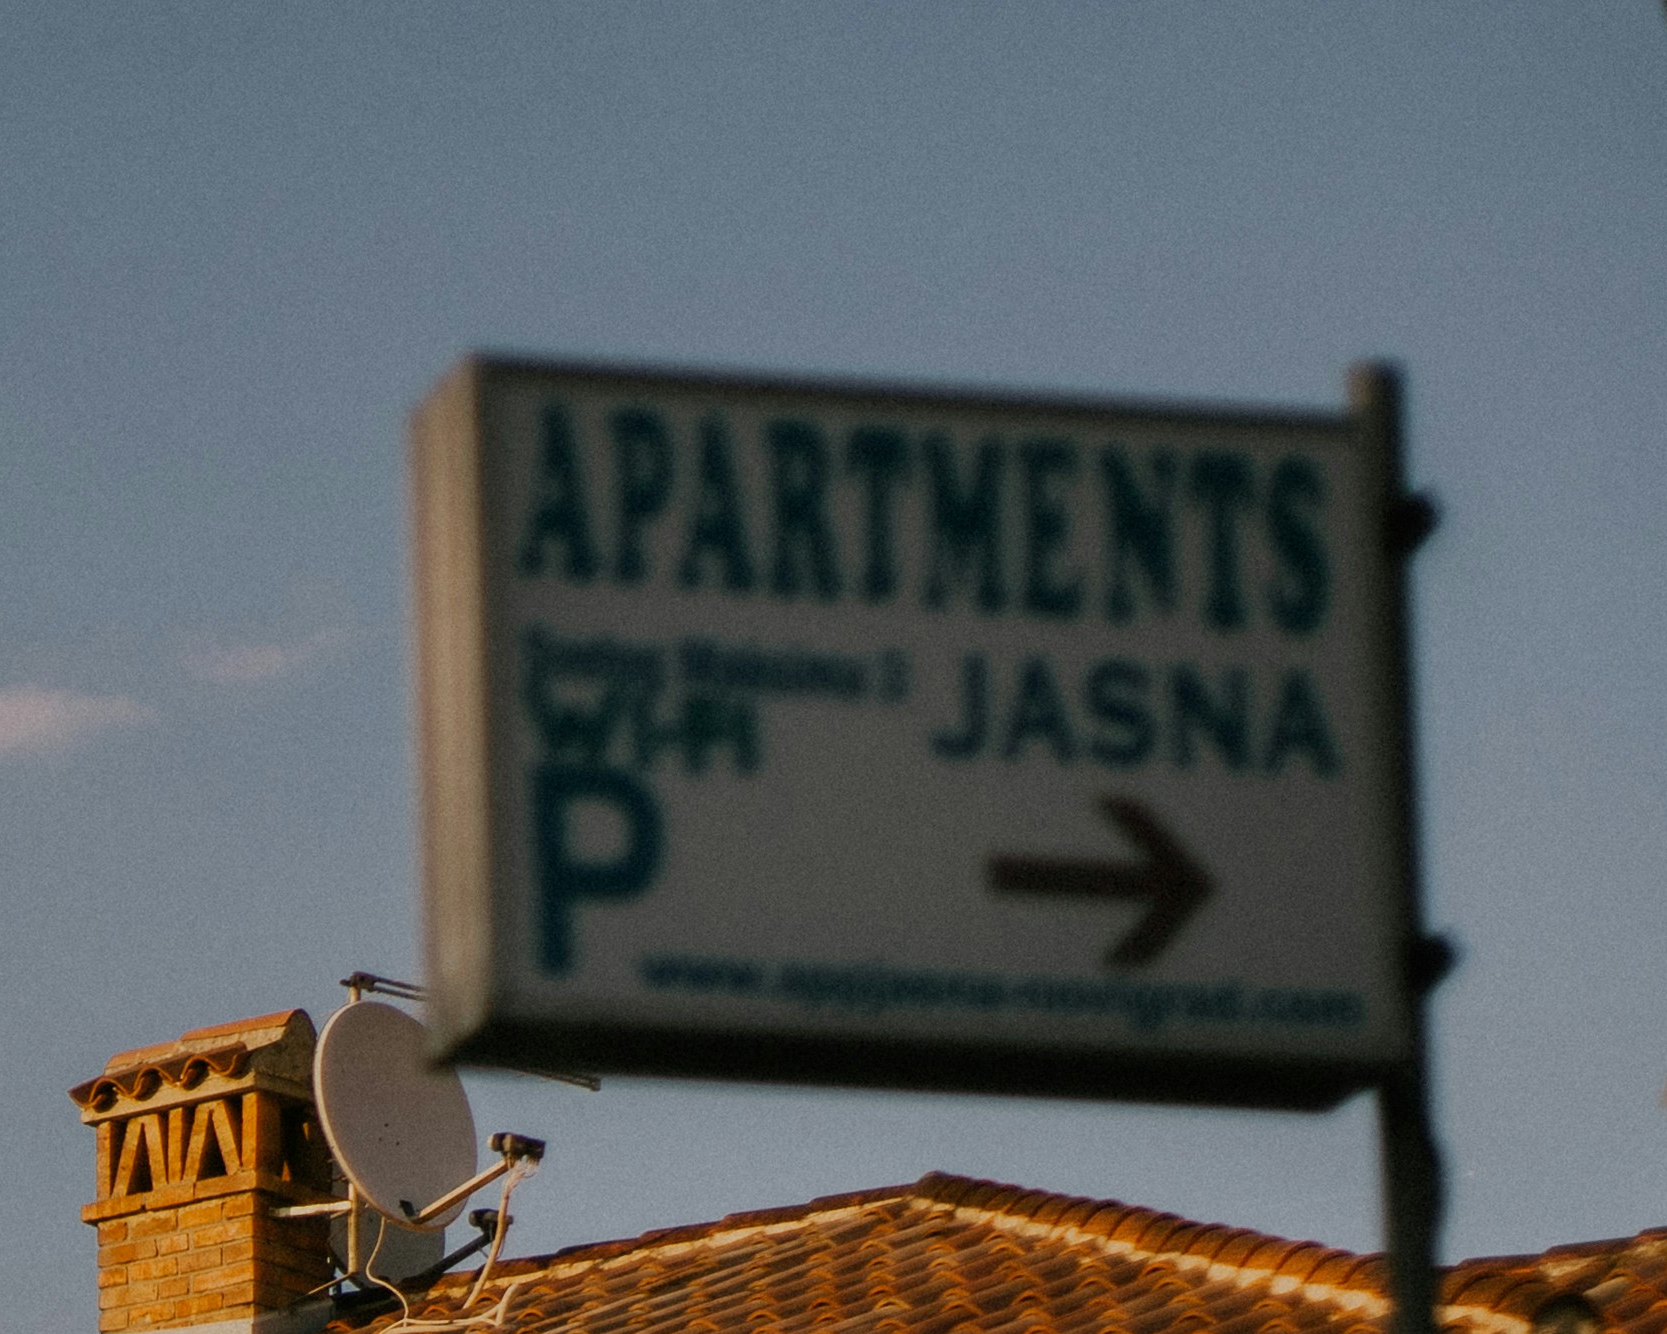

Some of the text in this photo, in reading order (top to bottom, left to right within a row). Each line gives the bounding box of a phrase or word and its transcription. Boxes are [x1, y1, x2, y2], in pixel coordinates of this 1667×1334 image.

[519, 402, 1334, 635] APARTMENTS
[930, 653, 1342, 777] JASNA
[530, 764, 665, 976] P
